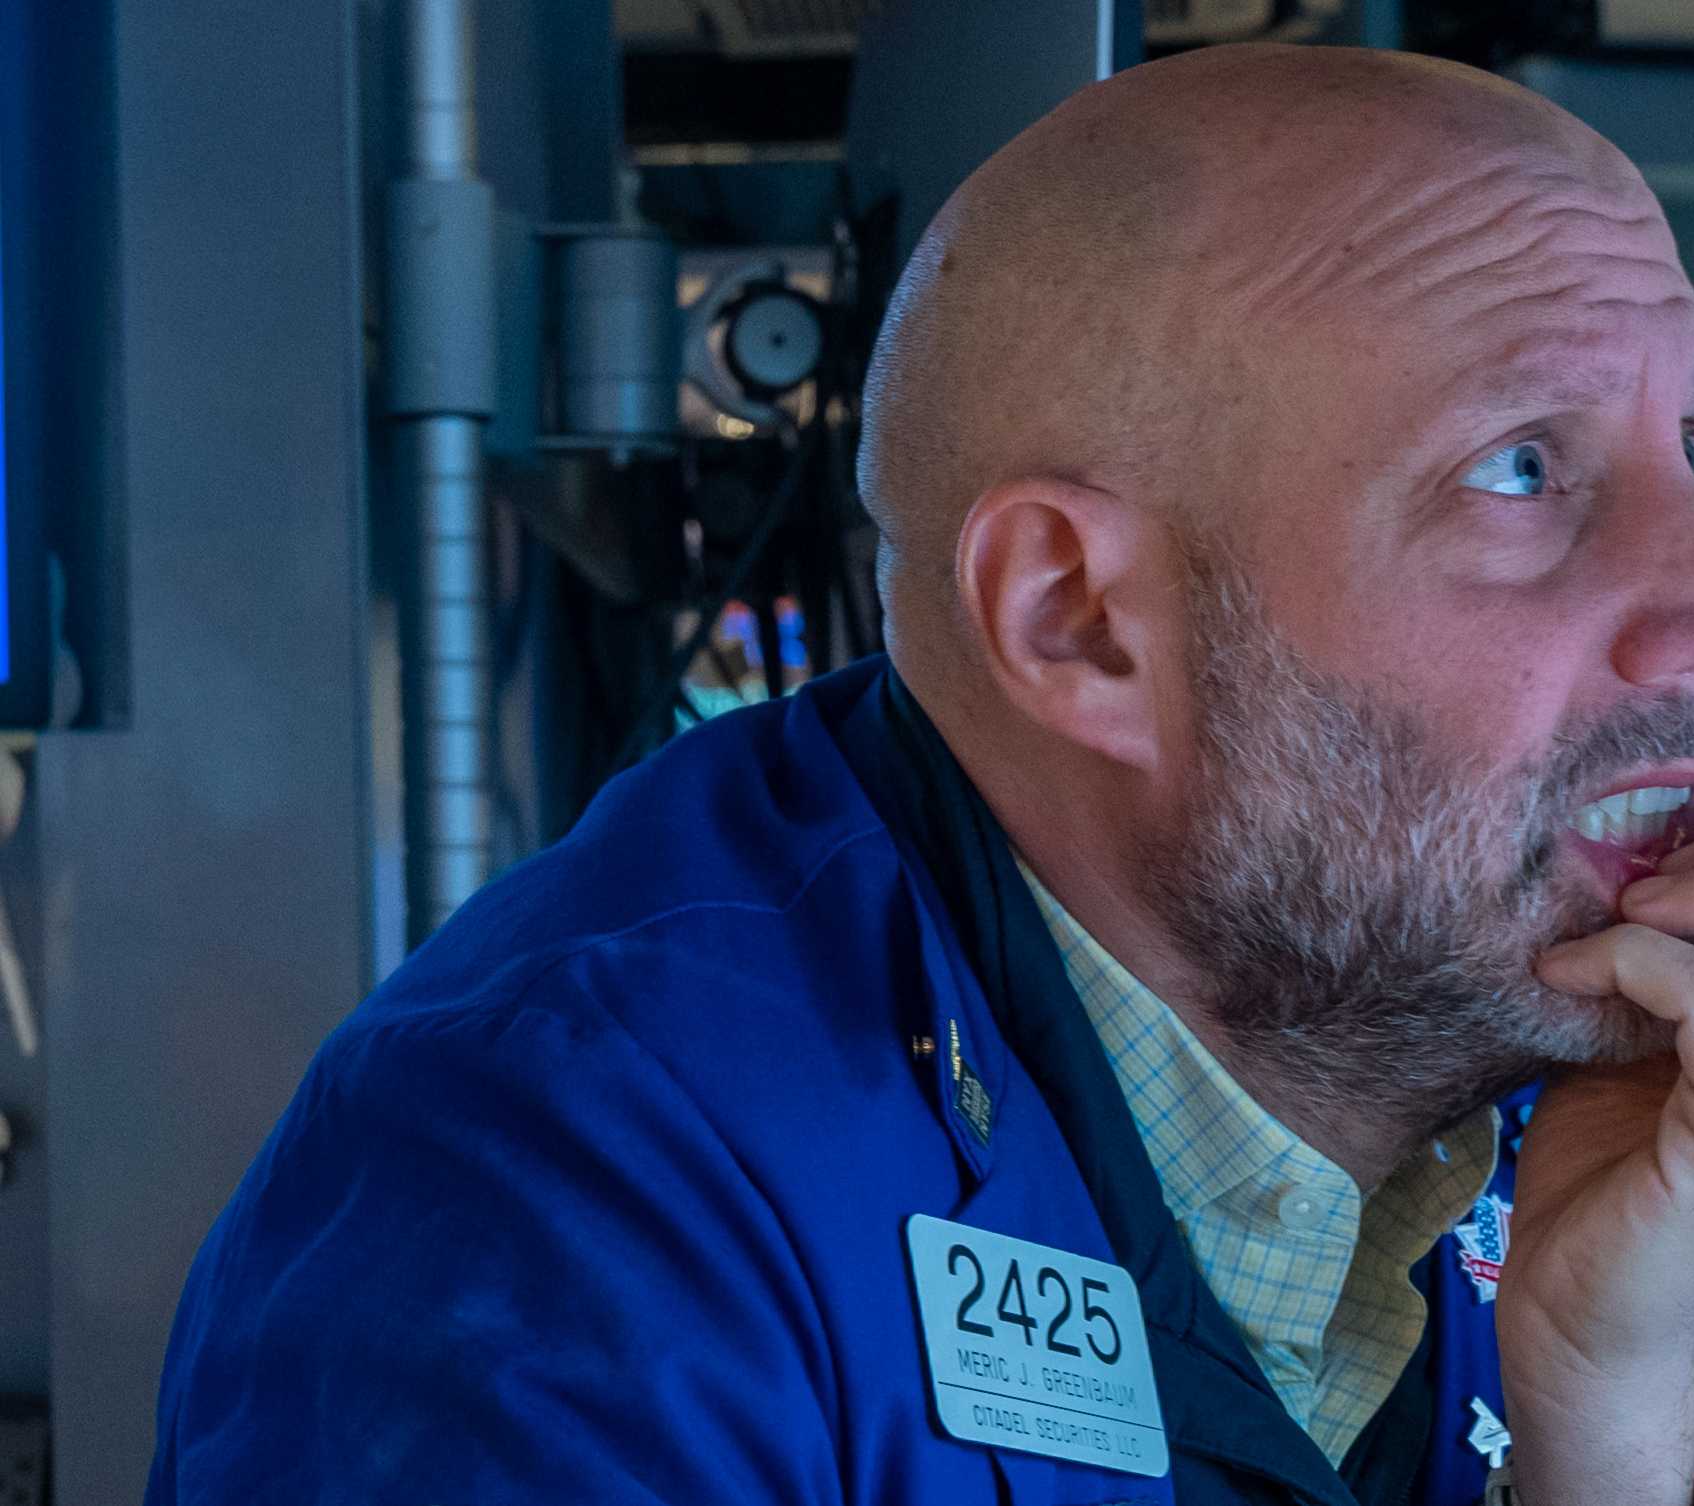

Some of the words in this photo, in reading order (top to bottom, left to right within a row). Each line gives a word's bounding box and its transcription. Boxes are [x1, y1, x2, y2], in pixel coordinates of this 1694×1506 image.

[948, 1244, 1122, 1366] 2425
[957, 1348, 1010, 1382] MERIC
[1018, 1363, 1034, 1387] J.
[1042, 1367, 1137, 1410] GREENBAUM
[973, 1404, 1031, 1435] CITADEL
[1035, 1417, 1111, 1451] SECURITIES
[1115, 1433, 1141, 1458] LLC
